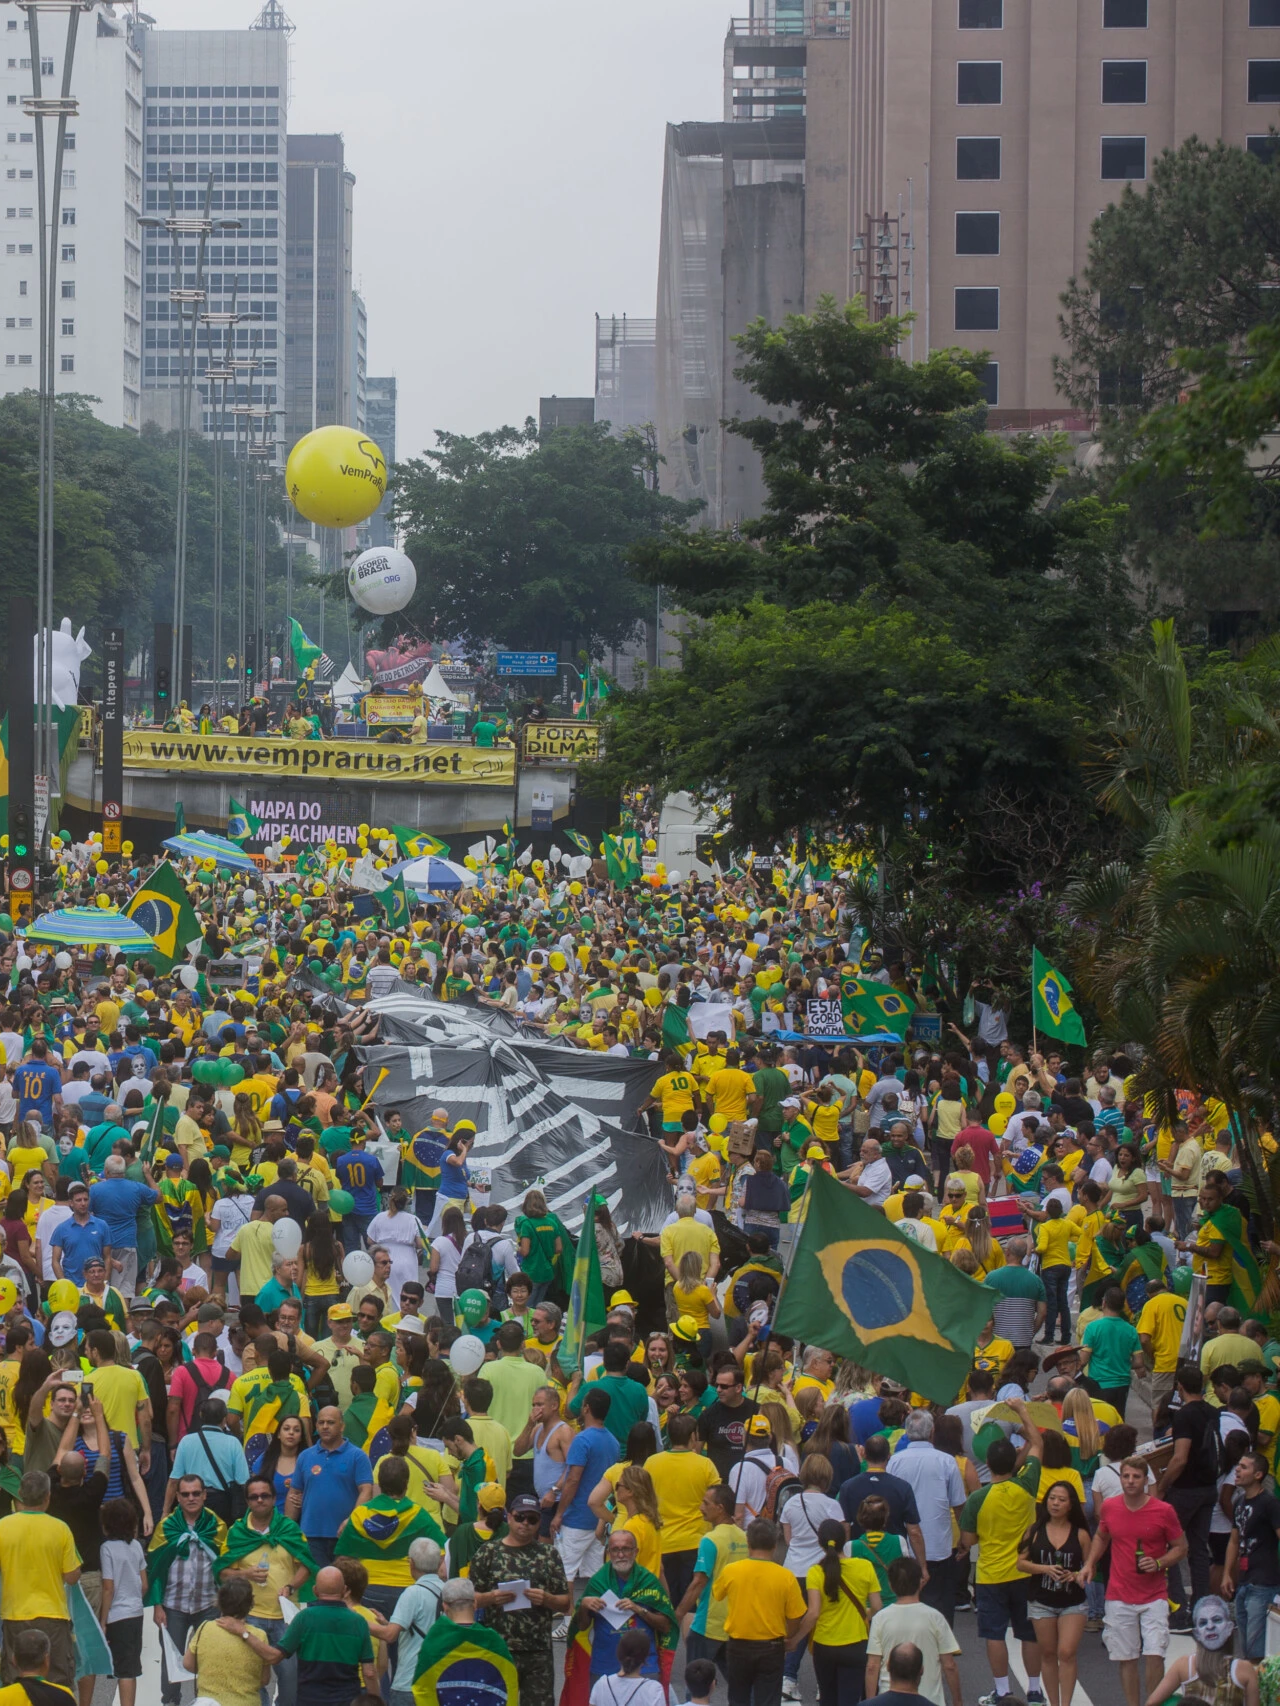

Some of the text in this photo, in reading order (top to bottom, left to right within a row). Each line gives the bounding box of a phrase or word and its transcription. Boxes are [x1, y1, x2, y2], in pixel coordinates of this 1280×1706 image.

[358, 558, 388, 571] ACORDA
[359, 563, 391, 579] BRASIL
[106, 660, 117, 705] Itapeva
[536, 727, 588, 741] FORA
[150, 741, 462, 775] www.vemprarua.net
[250, 800, 321, 821] MAPA DO
[250, 823, 360, 845] MPEACHMEN
[24, 1076, 42, 1100] 10
[670, 1077, 689, 1091] 10
[347, 1162, 366, 1188] 10
[466, 1297, 481, 1306] SOS
[718, 1426, 736, 1434] Hard
[1040, 1549, 1052, 1565] LA
